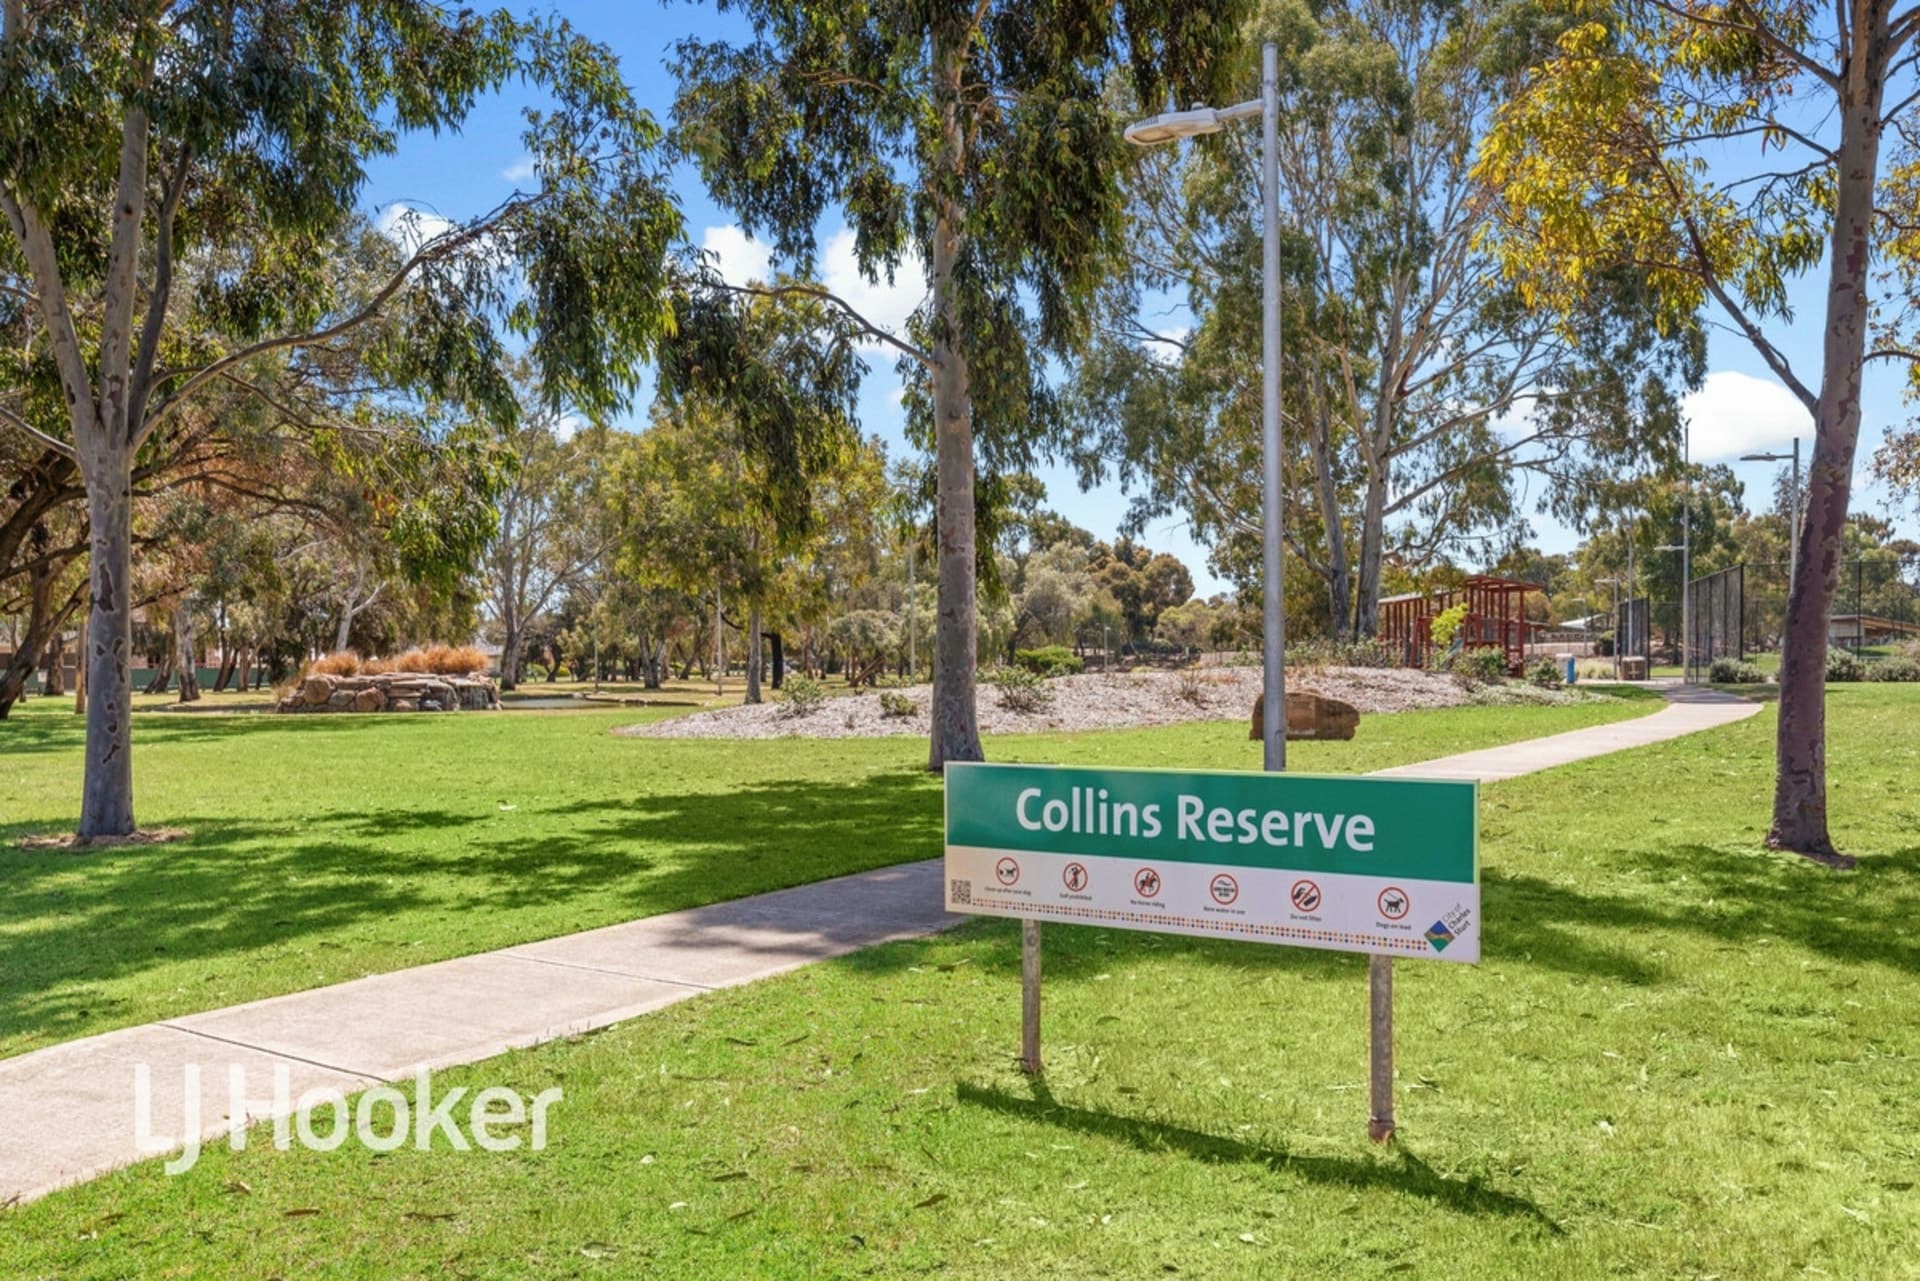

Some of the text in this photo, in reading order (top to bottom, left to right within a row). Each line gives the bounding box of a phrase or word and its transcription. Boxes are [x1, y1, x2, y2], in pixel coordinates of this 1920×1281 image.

[1016, 787, 1375, 852] Collins Reserve
[1442, 910, 1456, 923] City
[1447, 908, 1471, 930] Charles
[1454, 920, 1471, 936] Sturt
